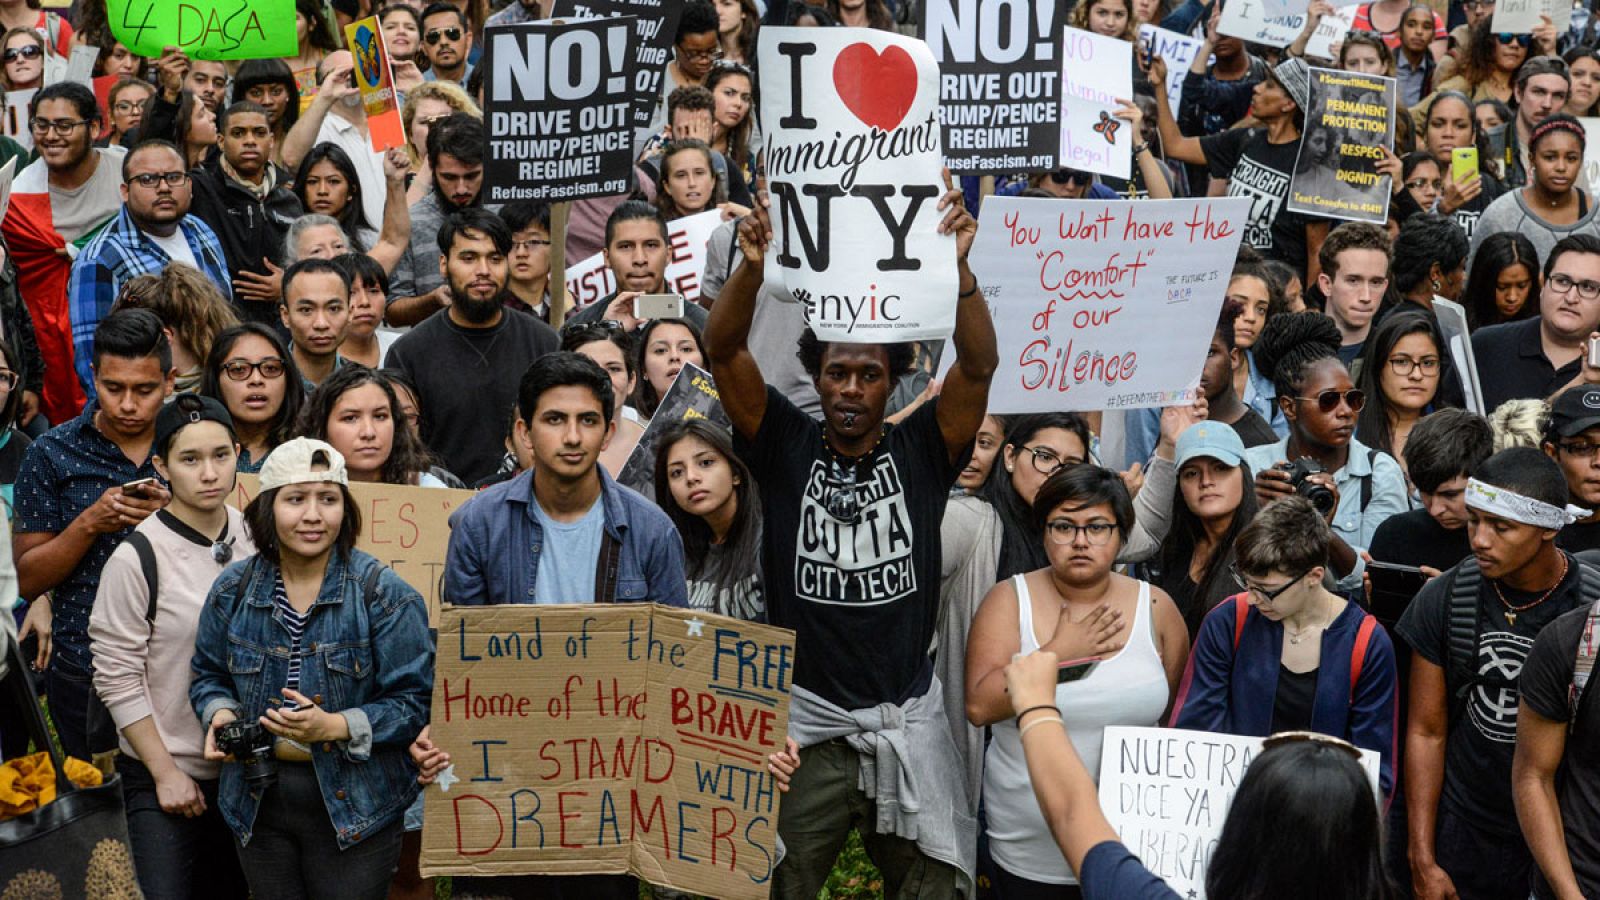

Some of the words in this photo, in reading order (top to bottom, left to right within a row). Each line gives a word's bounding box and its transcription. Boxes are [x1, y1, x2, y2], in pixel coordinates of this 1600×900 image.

[925, 0, 1055, 64] NO!
[492, 26, 628, 101] NO!
[635, 69, 660, 93] O!
[777, 42, 817, 129] I
[941, 74, 1000, 100] RIVE
[1008, 71, 1057, 99] OUT
[491, 109, 571, 136] DRIVE
[579, 102, 630, 131] OUT
[938, 102, 1057, 127] RUMP/PENCE
[1322, 114, 1386, 133] PROTECTION
[1326, 99, 1387, 118] PERMANENT
[490, 130, 630, 159] TRUMP/PENCE
[766, 111, 936, 191] Immigrant
[949, 127, 1029, 149] REGIME!
[492, 179, 626, 199] RefuseFascism.org
[519, 156, 601, 181] REGIME!
[1336, 169, 1380, 186] DIGNITY
[770, 181, 940, 273] NY
[1004, 210, 1041, 247] You
[1123, 206, 1174, 240] have
[1185, 204, 1235, 242] the
[821, 284, 901, 333] nyic
[1032, 300, 1056, 332] of
[1072, 305, 1122, 329] our
[802, 502, 911, 564] OUTTA
[802, 562, 849, 600] CITY
[853, 558, 911, 600] TECH
[460, 617, 543, 661] Land
[565, 617, 597, 659] of
[622, 618, 685, 667] the
[713, 629, 792, 693] FREE
[443, 677, 530, 722] Home
[547, 675, 583, 720] of
[592, 677, 648, 720] the
[671, 687, 777, 746] BRAVE
[470, 740, 507, 782] I
[539, 736, 675, 784] STAND
[695, 761, 774, 812] WITH
[1120, 782, 1171, 820] DICE
[1184, 787, 1212, 828] YA
[453, 788, 772, 883] DREAMERS
